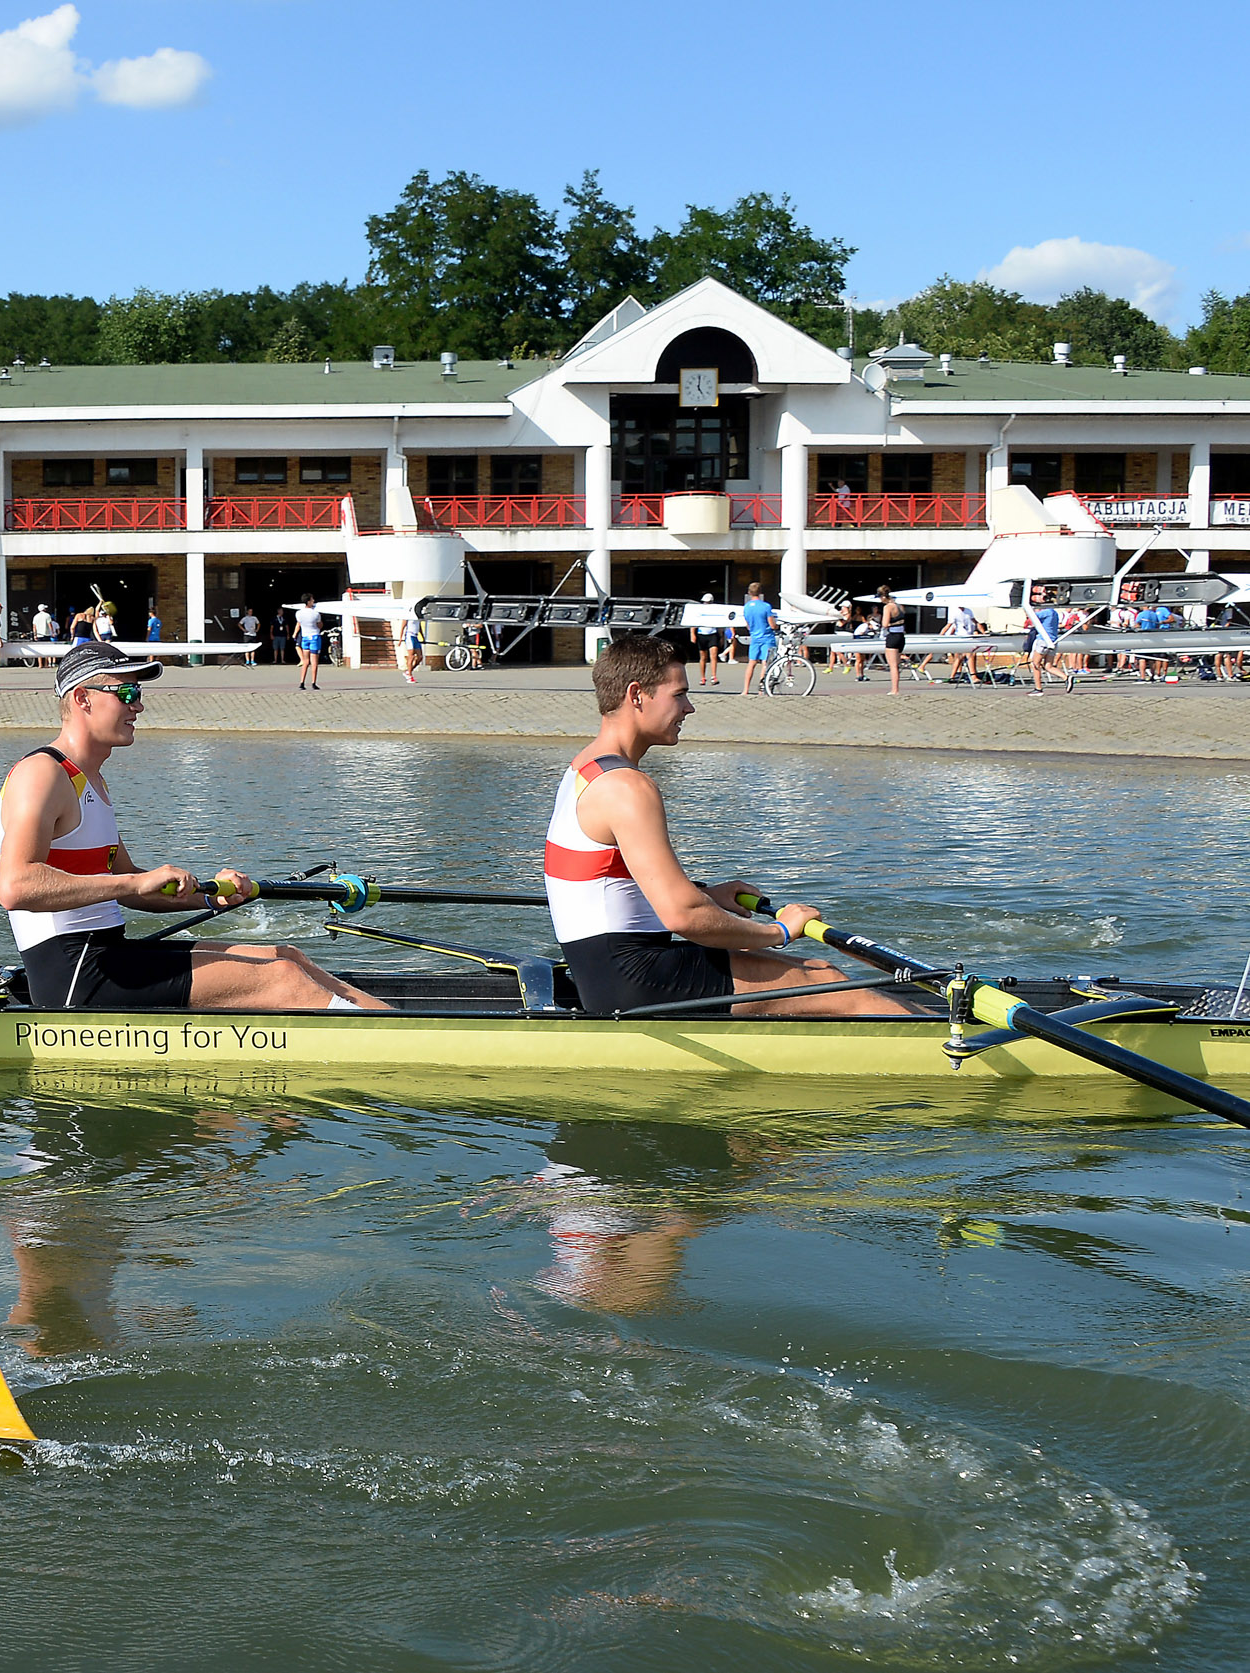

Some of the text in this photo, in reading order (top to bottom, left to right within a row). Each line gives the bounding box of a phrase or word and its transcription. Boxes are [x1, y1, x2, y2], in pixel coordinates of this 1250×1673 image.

[1088, 500, 1187, 515] ABILITACJA
[1224, 502, 1250, 516] ME
[15, 1021, 287, 1054] Pioneering for You
